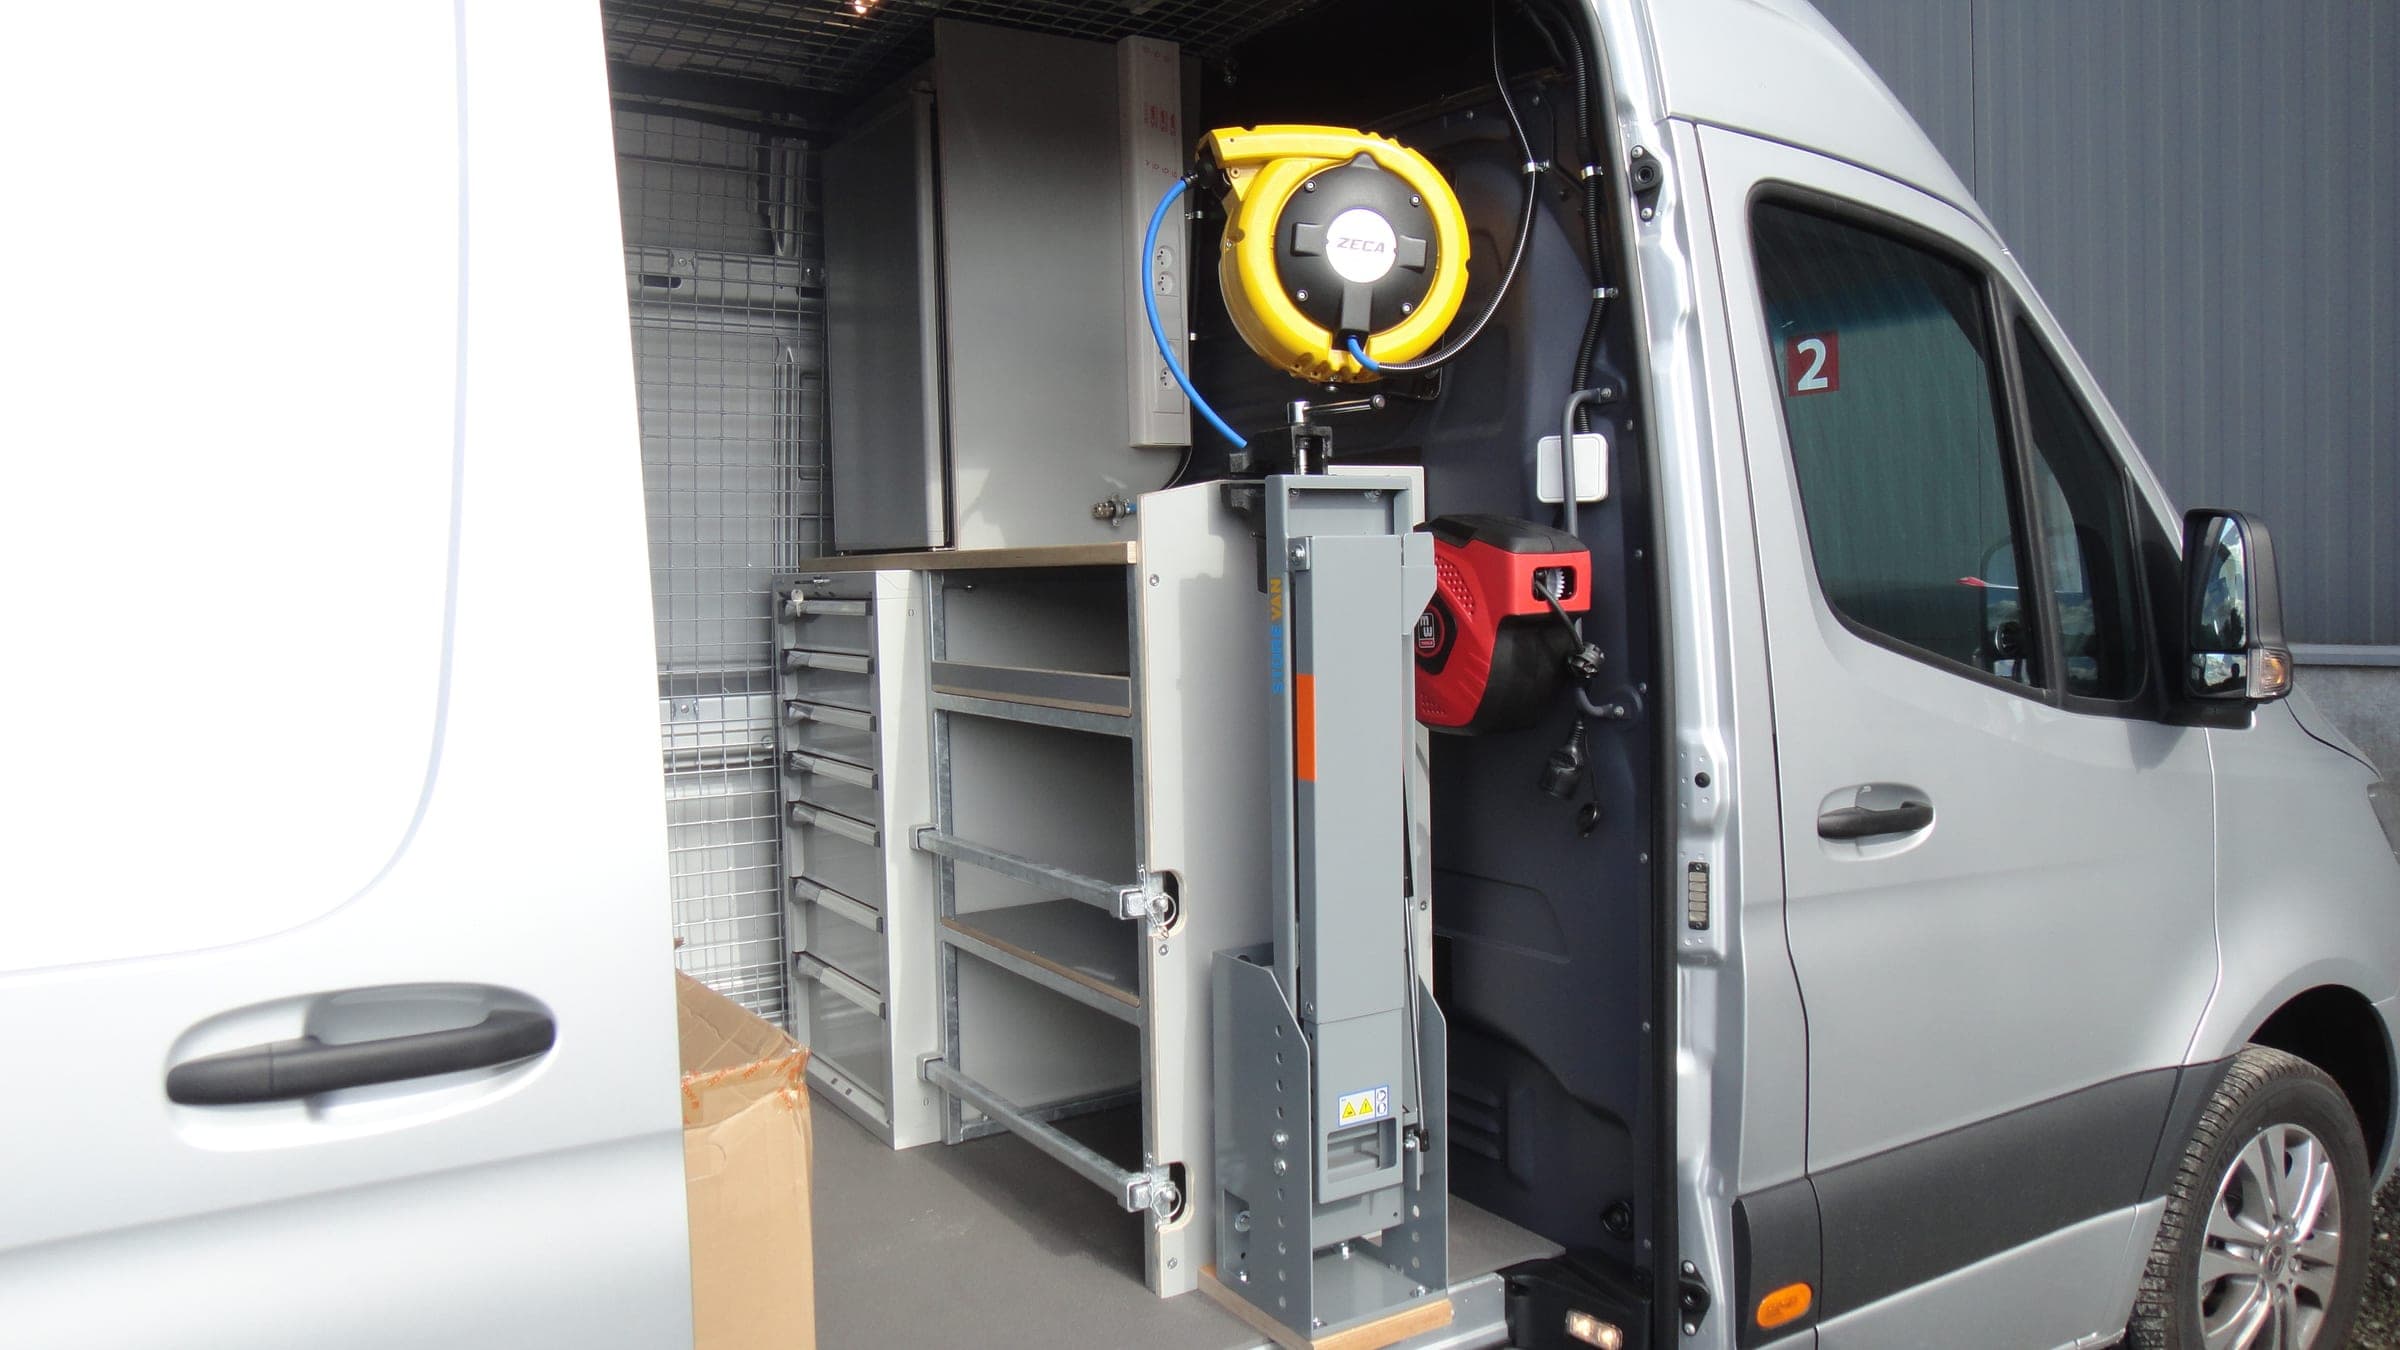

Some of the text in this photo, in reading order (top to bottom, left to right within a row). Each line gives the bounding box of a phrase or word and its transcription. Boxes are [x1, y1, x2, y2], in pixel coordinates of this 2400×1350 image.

[1336, 237, 1385, 253] ZECA
[1797, 338, 1828, 391] 2
[1270, 578, 1282, 621] VAN
